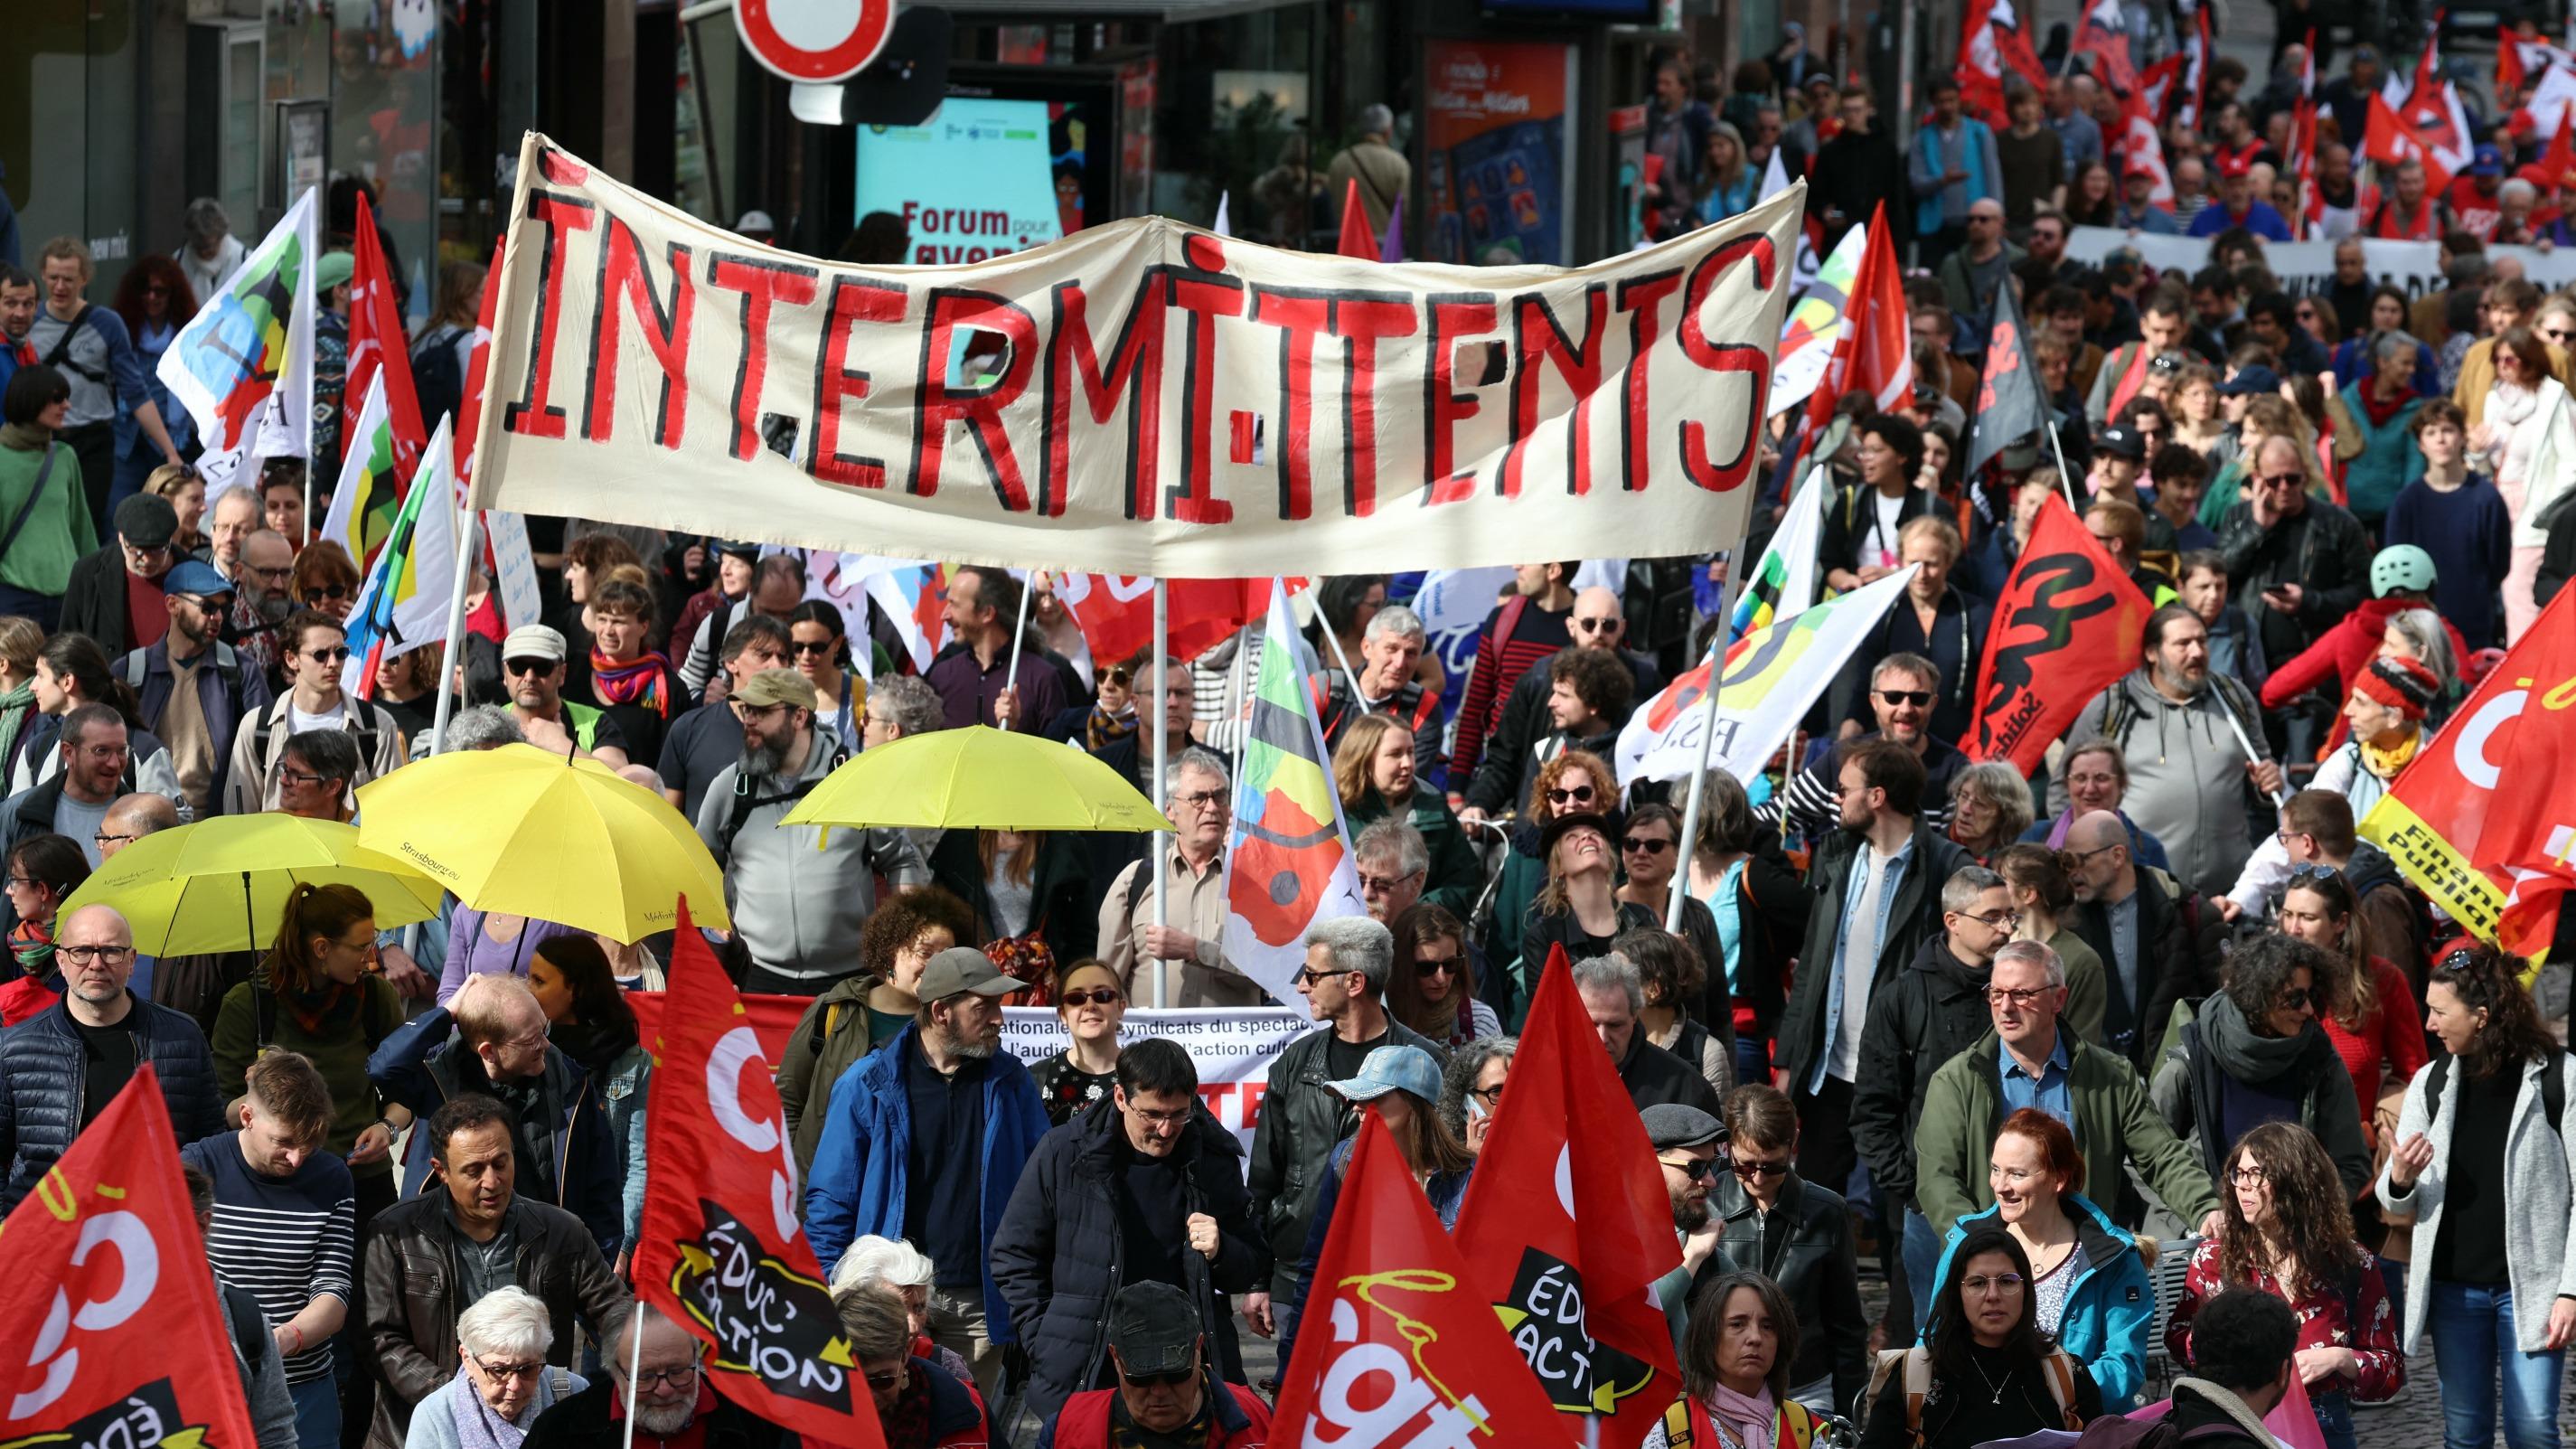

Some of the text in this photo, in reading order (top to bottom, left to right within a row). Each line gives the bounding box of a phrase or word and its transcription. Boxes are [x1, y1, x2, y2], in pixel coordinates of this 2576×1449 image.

[903, 201, 1050, 236] Forum pour
[504, 146, 1777, 525] INTERMITTENTS
[400, 842, 461, 880] Strasbourg.eu
[1000, 1018, 1314, 1038] ationale syndicats du spectac
[1255, 1040, 1292, 1056] cult
